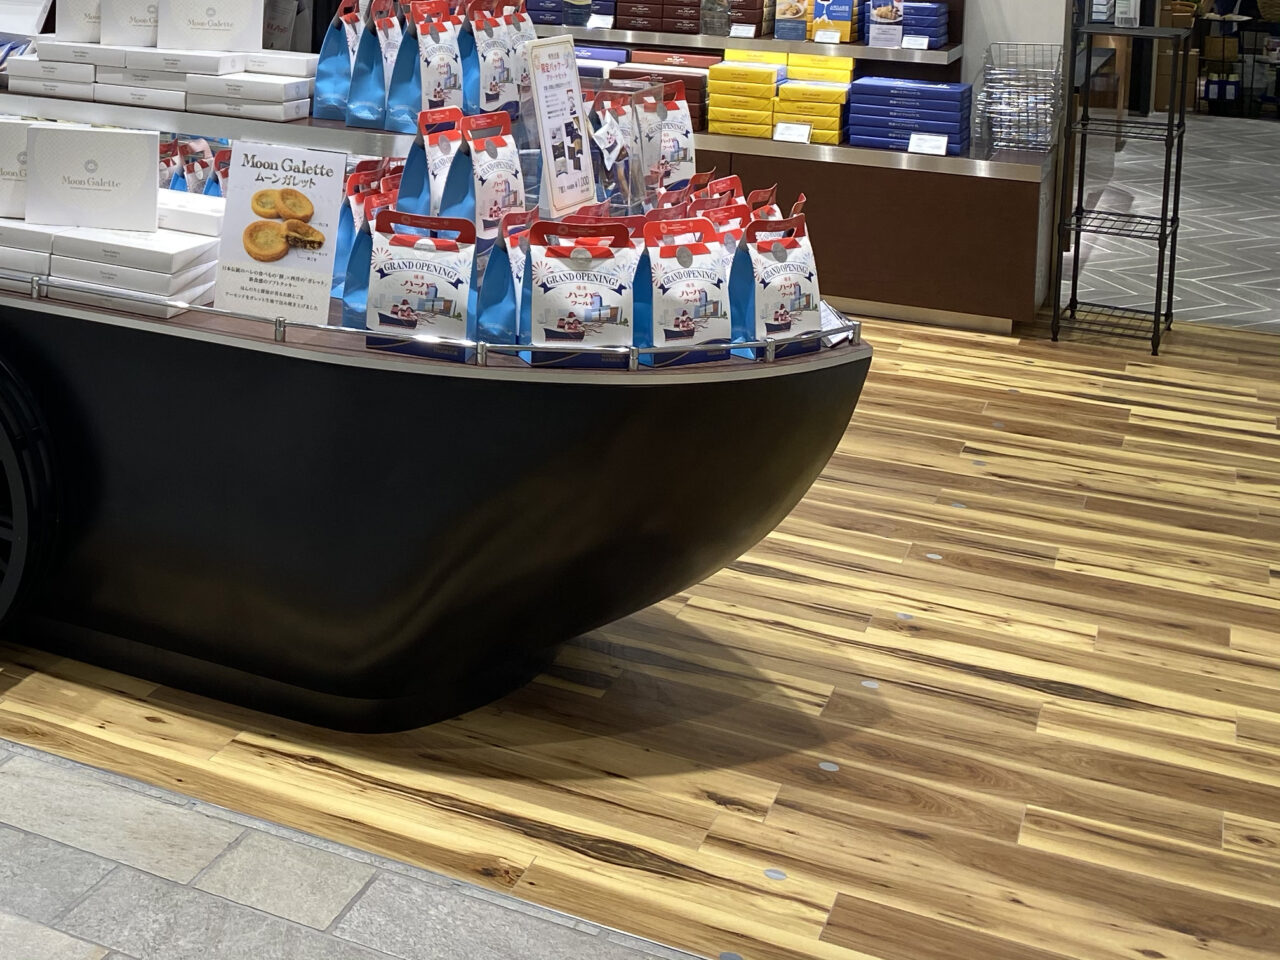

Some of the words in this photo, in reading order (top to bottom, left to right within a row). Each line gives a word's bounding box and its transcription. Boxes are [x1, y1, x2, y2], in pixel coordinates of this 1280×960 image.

[187, 19, 208, 27] Moon
[208, 20, 234, 28] Galette
[240, 153, 279, 171] Moon
[280, 157, 335, 178] Galette
[61, 175, 86, 186] Moon
[86, 177, 121, 188] Galette
[255, 173, 317, 189] ムーンガレット
[383, 261, 414, 272] GRAND
[415, 262, 457, 280] OPENING!
[763, 265, 781, 281] GRAND
[546, 272, 575, 286] GRAND
[575, 272, 619, 287] OPENING!
[663, 271, 683, 286] GRAND
